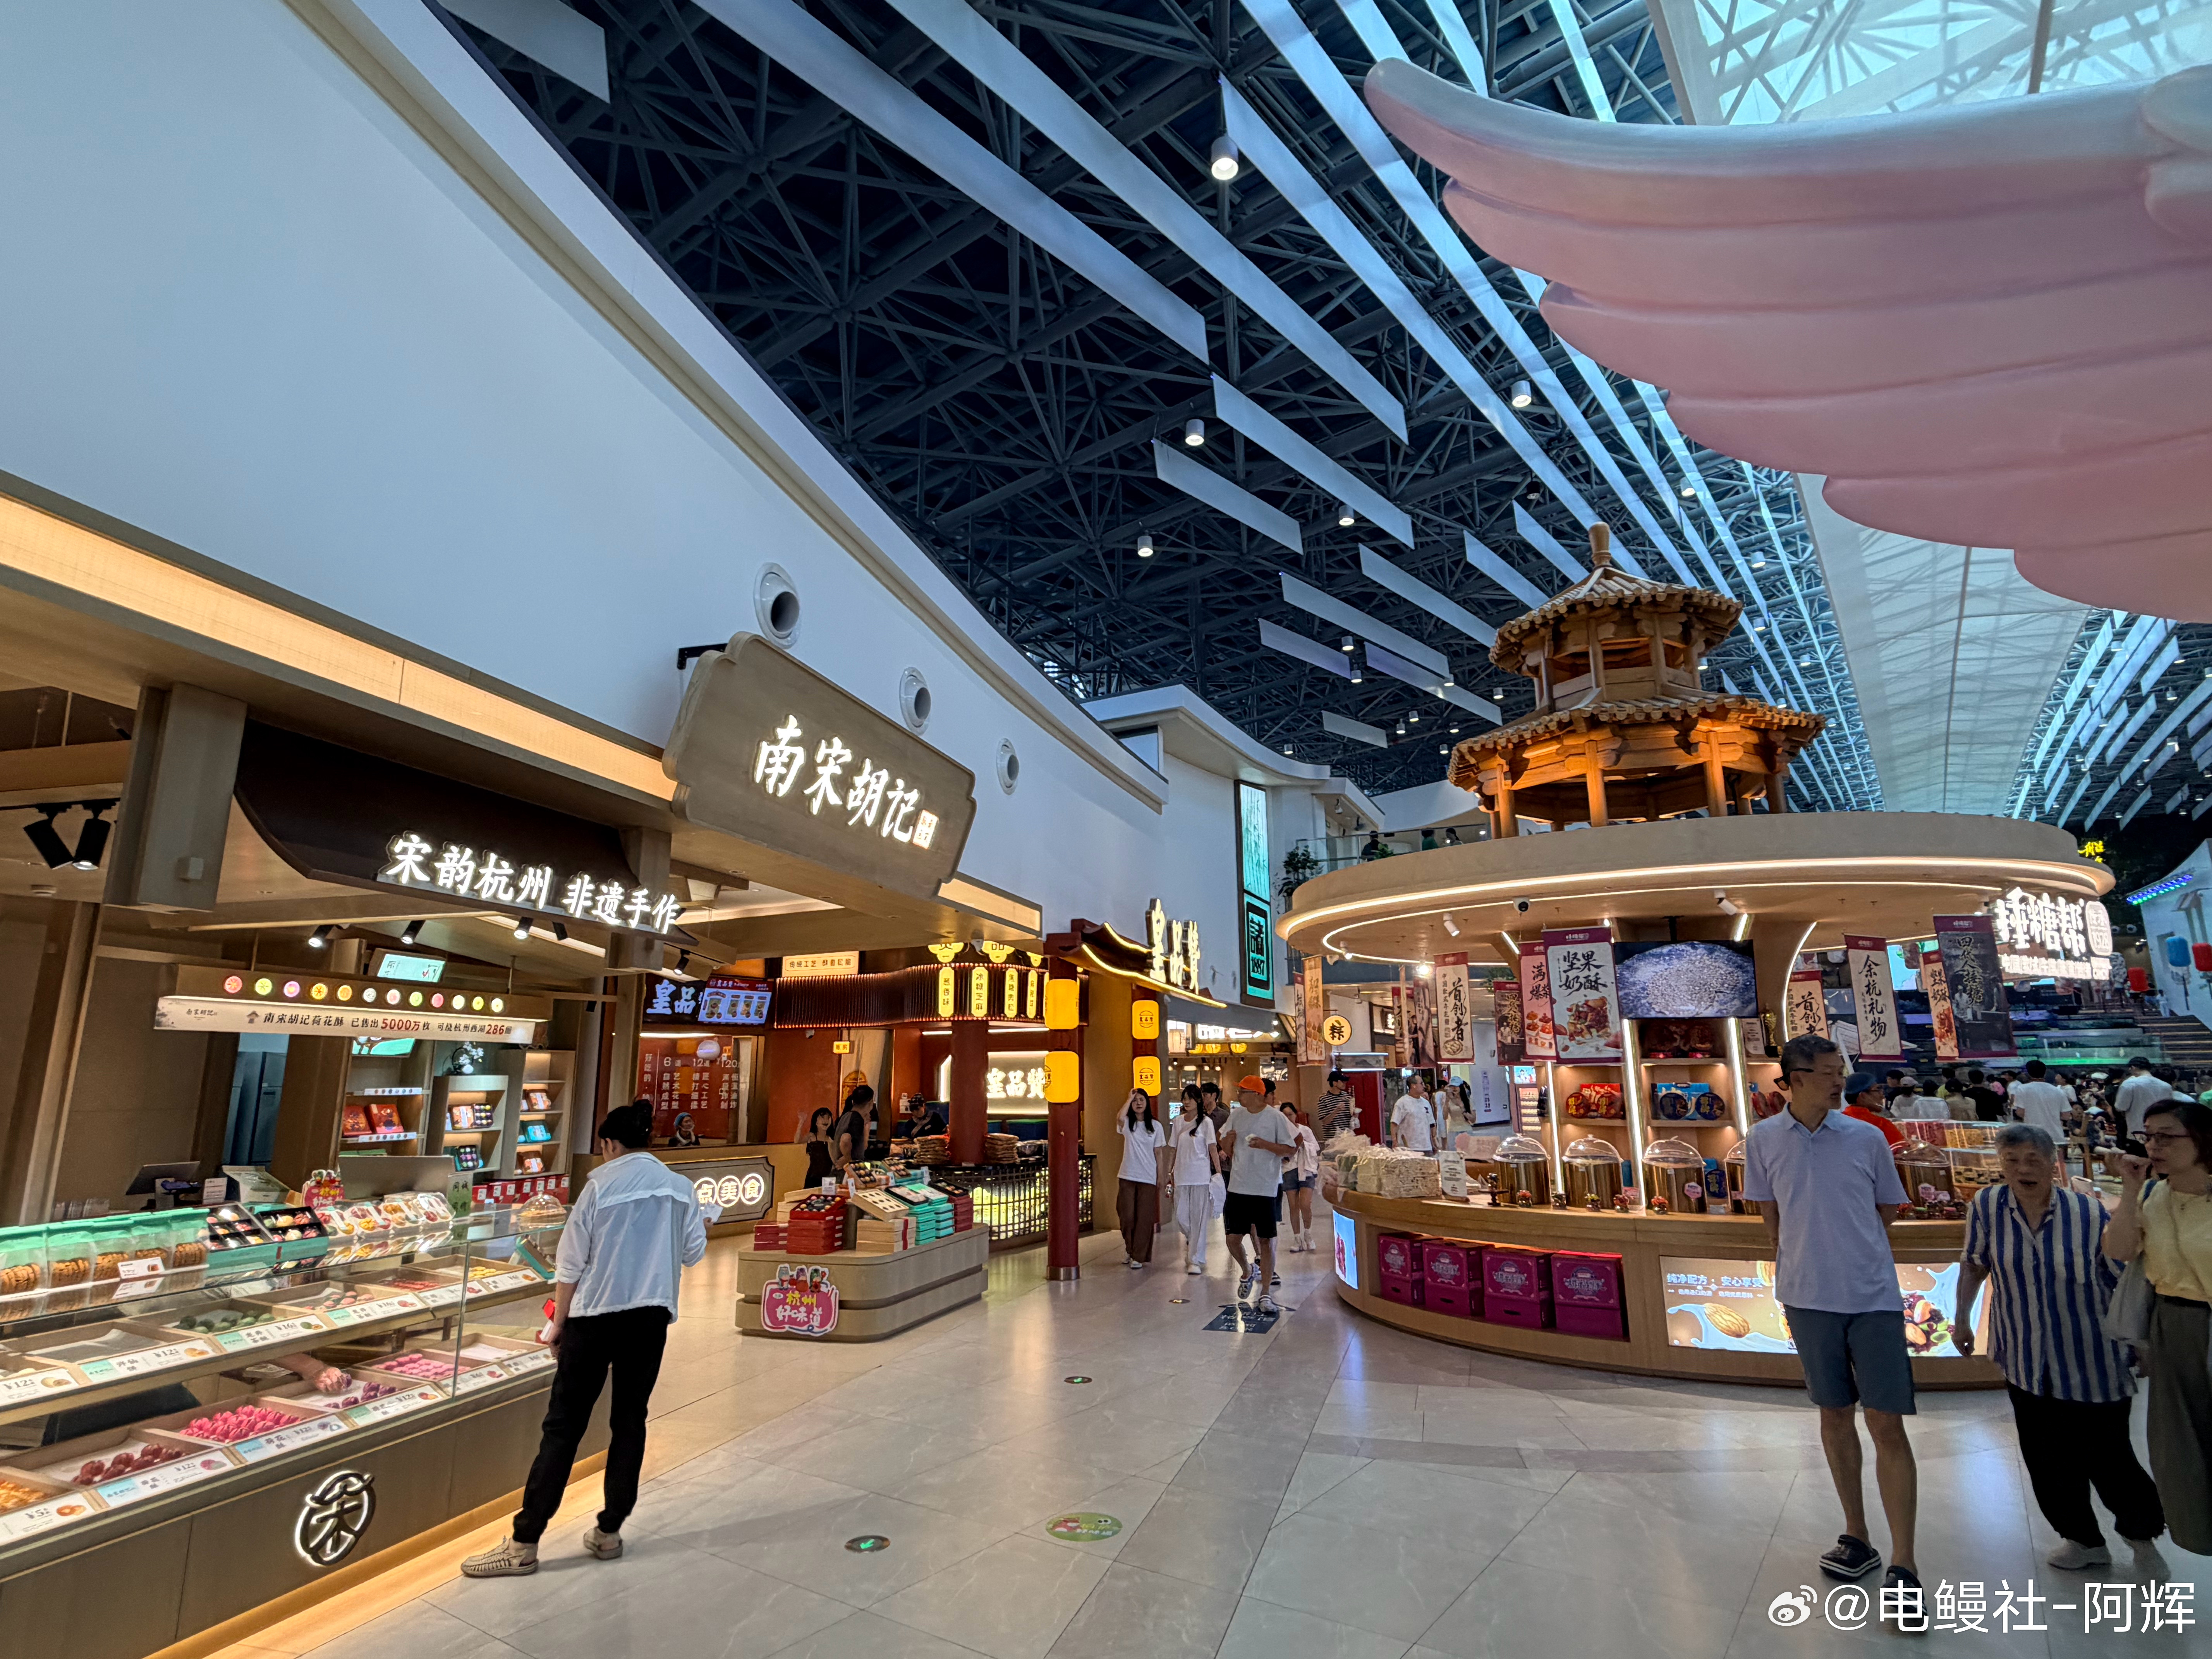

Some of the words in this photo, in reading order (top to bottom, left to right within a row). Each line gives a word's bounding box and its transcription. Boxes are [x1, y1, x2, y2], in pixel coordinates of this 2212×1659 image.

[754, 714, 920, 843] 南宋胡记
[386, 833, 552, 909] 宋韵杭州
[562, 874, 680, 933] 非遗手作
[1251, 957, 1265, 975] 1887
[1563, 950, 1605, 973] 坚果
[646, 979, 704, 1015] 皇品
[1559, 972, 1608, 997] 奶酥
[1449, 977, 1468, 1041] 首创者
[1859, 955, 1887, 1045] 余杭礼物
[263, 1013, 344, 1027] 南宋胡记荷花酥
[697, 1179, 760, 1204] 点美食
[786, 1290, 816, 1307] 杭州
[776, 1305, 822, 1326] 好味道
